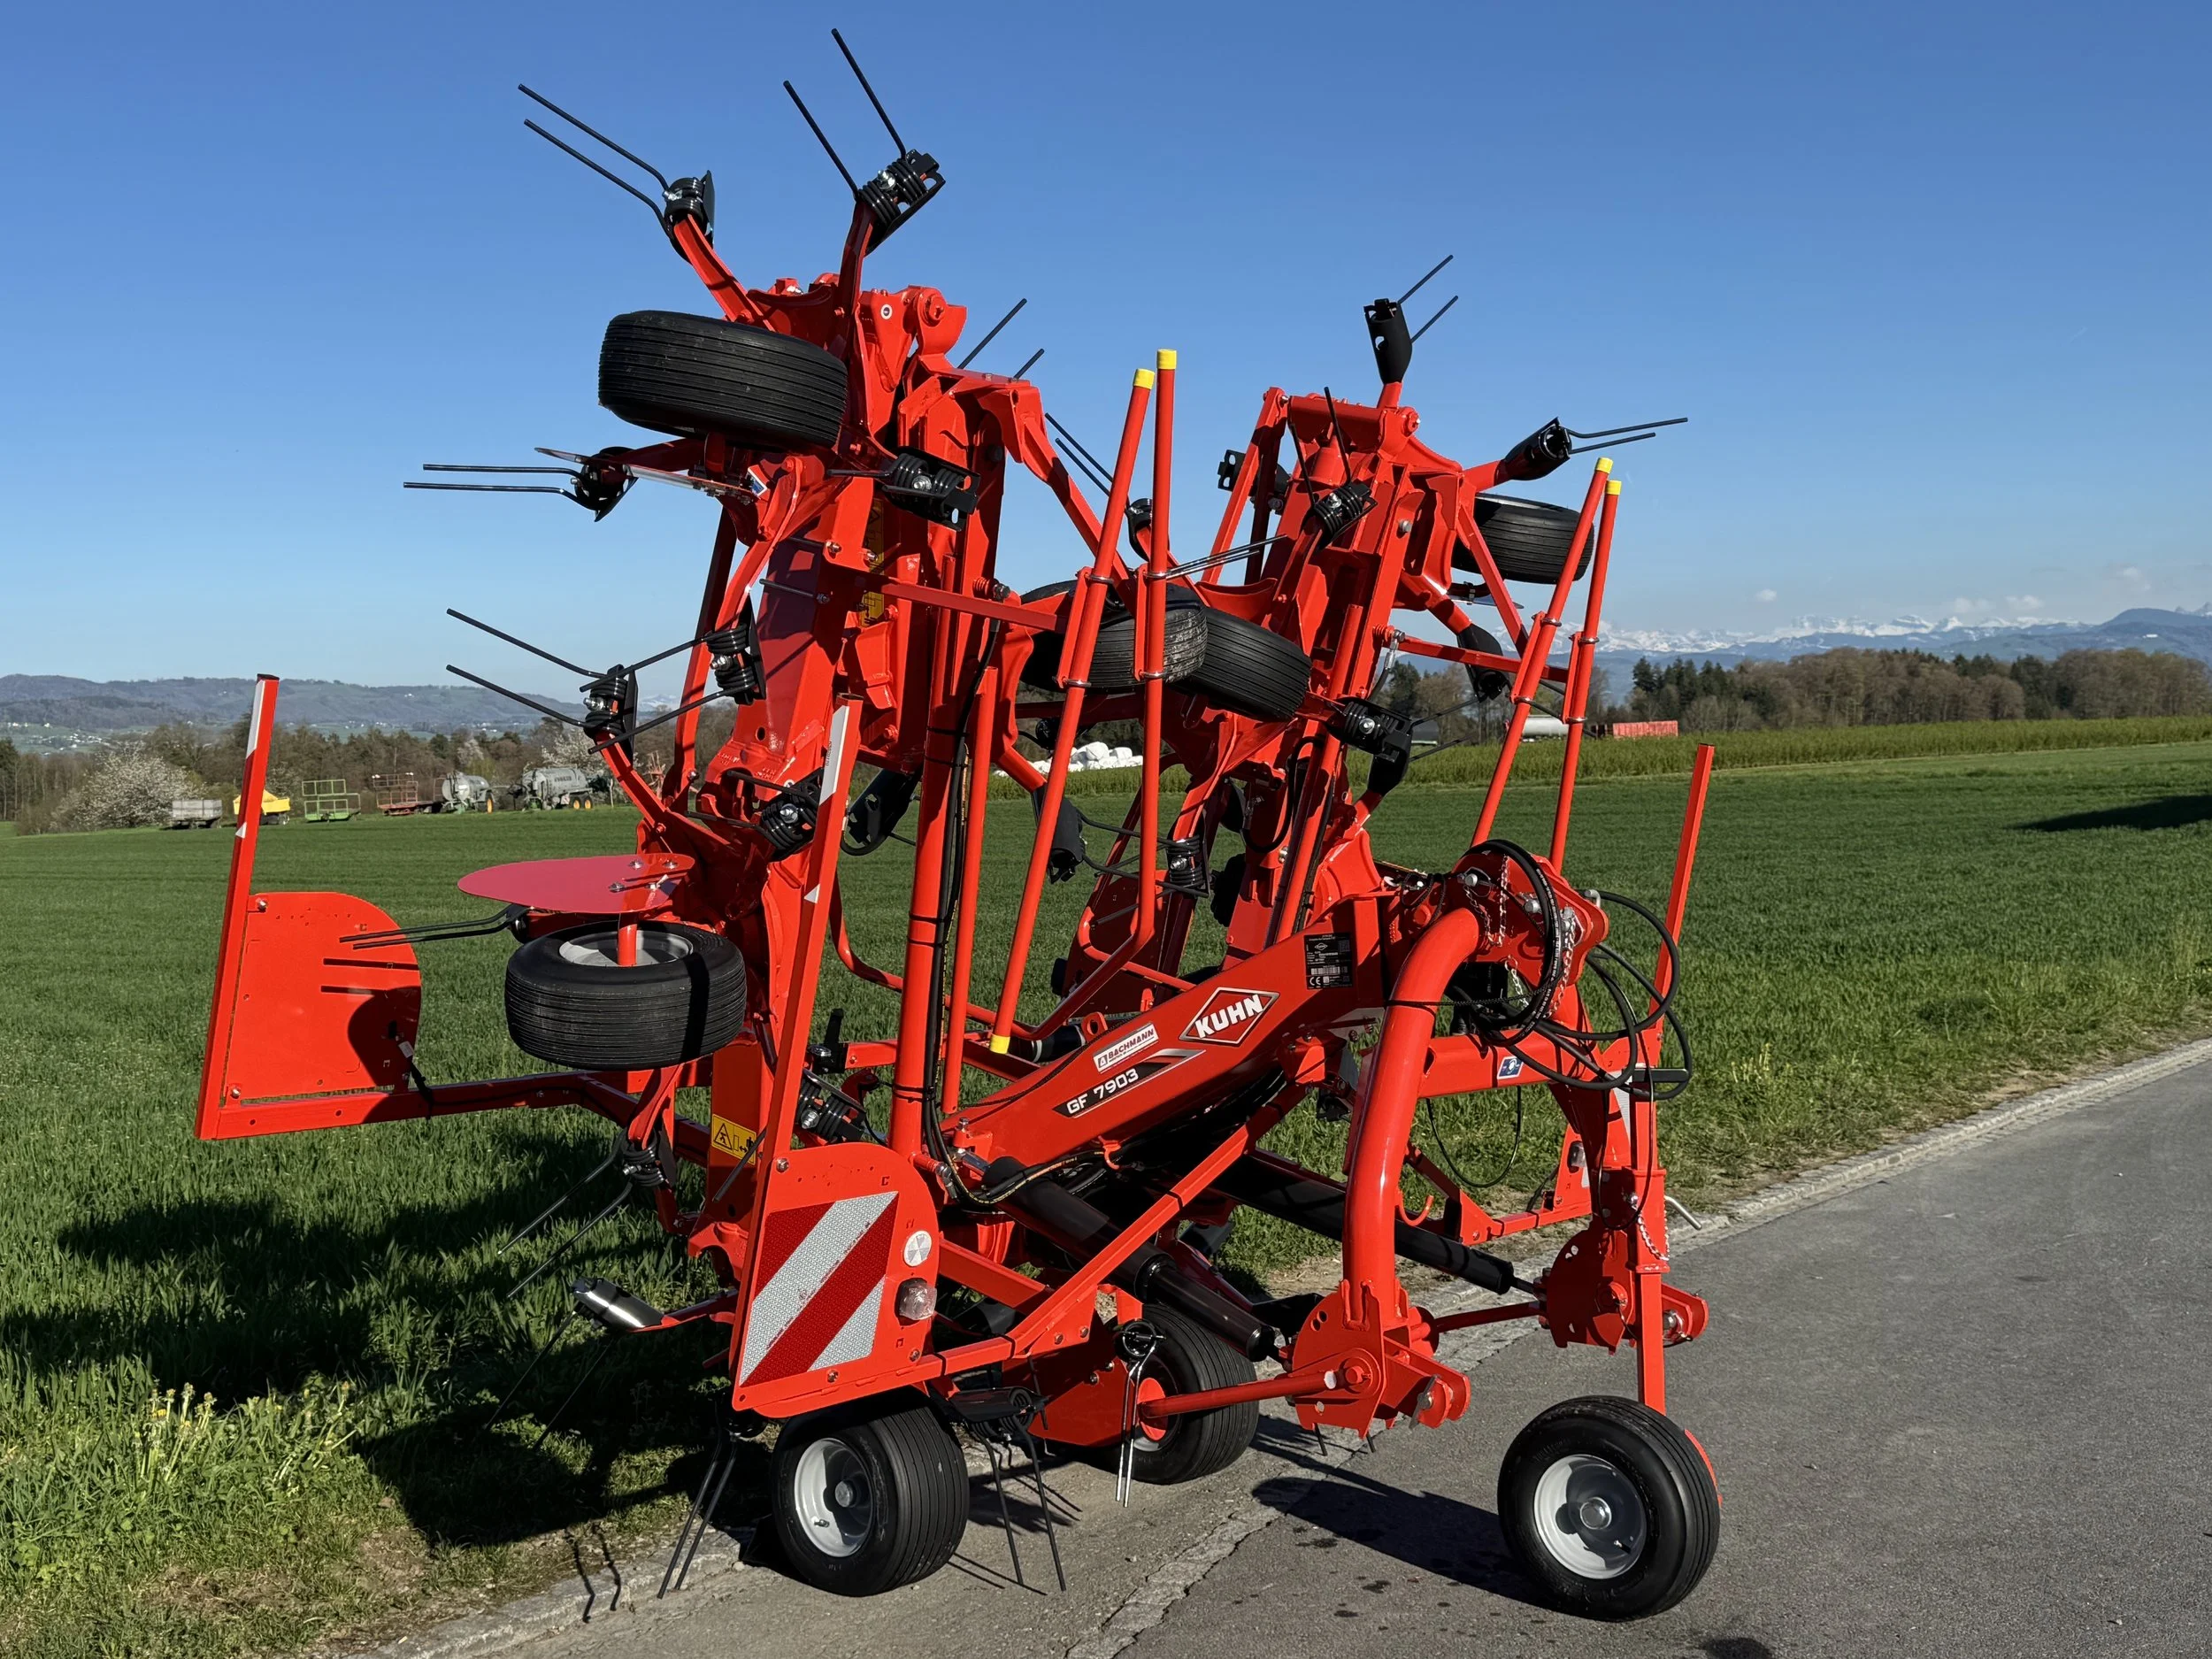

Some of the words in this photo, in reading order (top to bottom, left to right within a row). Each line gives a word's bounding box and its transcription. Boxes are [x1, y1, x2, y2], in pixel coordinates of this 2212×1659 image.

[1194, 994, 1264, 1039] KUHN
[1108, 1028, 1155, 1059] BACHMANN
[1066, 1093, 1088, 1115] GF
[1093, 1067, 1140, 1100] 7903
